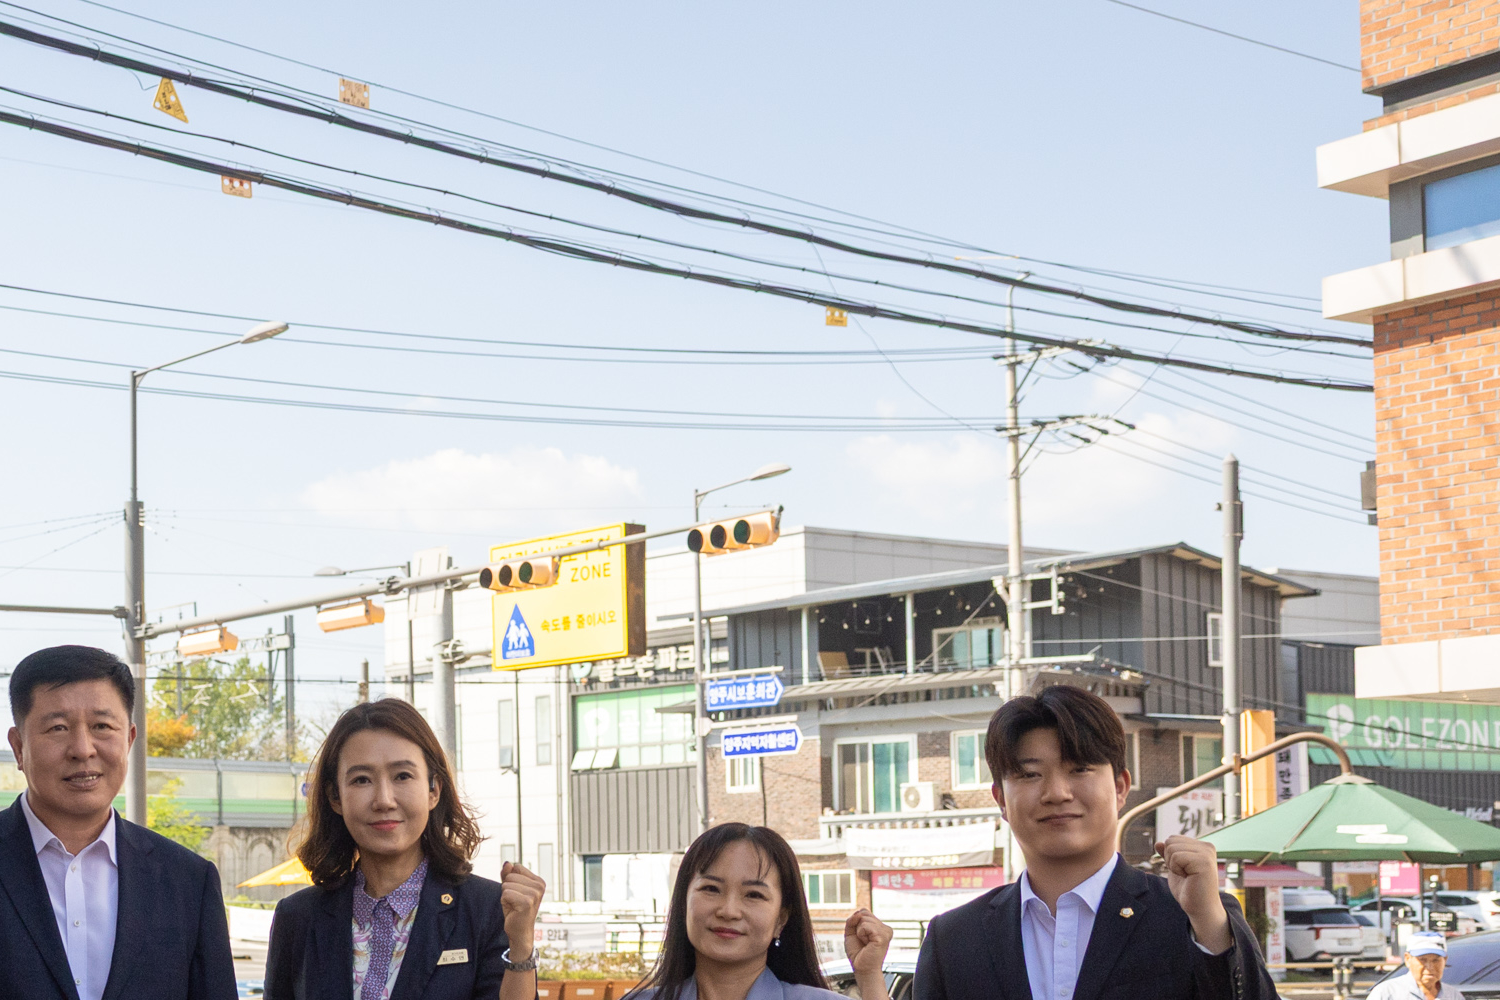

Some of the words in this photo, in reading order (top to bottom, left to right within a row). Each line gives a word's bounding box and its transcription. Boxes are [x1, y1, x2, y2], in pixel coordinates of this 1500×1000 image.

[570, 562, 612, 583] ZONE
[541, 616, 571, 633] 속도를
[576, 610, 617, 629] 줄이시오
[709, 682, 777, 705] 양주시보훈회관
[547, 929, 568, 941] 안내
